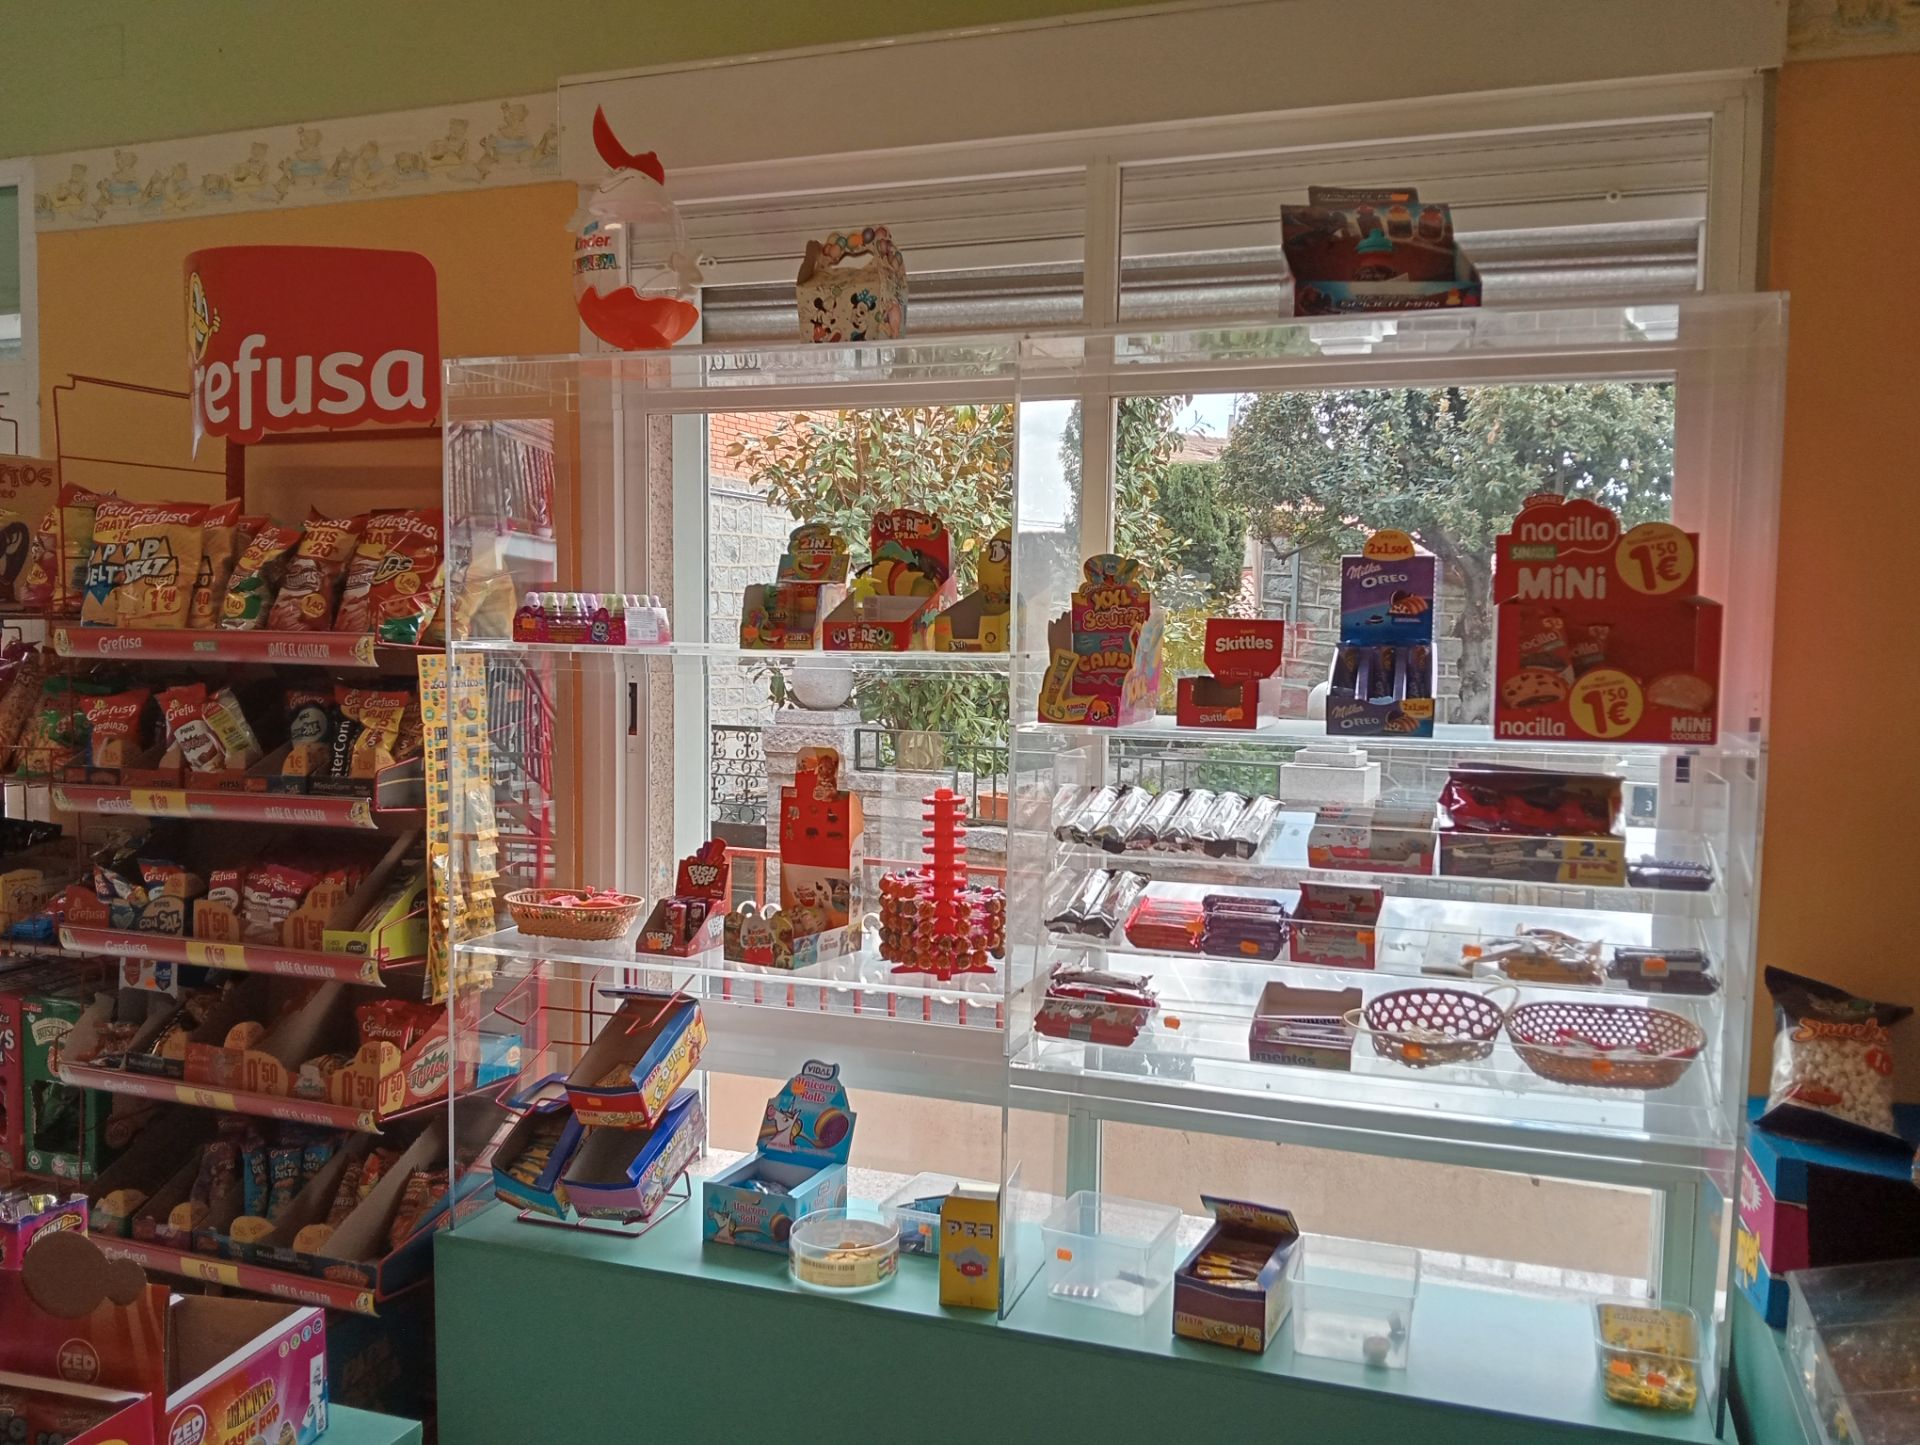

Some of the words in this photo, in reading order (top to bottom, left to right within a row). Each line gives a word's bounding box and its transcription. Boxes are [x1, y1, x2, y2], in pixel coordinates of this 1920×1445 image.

[129, 509, 191, 526] Grefusa
[1520, 516, 1609, 542] nocilla
[1346, 561, 1382, 580] Milka
[1361, 574, 1408, 588] OREO
[99, 635, 143, 653] Grefusa
[1215, 635, 1274, 653] Skittles
[165, 705, 196, 722] Grefu
[1340, 717, 1380, 729] OREO
[1499, 717, 1567, 737] nocilla
[97, 796, 132, 811] Grefus
[687, 864, 718, 878] PUSH
[139, 916, 159, 930] CON
[159, 911, 182, 932] SAL
[105, 940, 148, 954] Grefusa
[807, 1066, 831, 1076] VIDAL
[800, 1091, 826, 1104] Rolls
[733, 1202, 768, 1217] Unicorn
[61, 1351, 96, 1371] ZED
[172, 1414, 205, 1443] ZED
